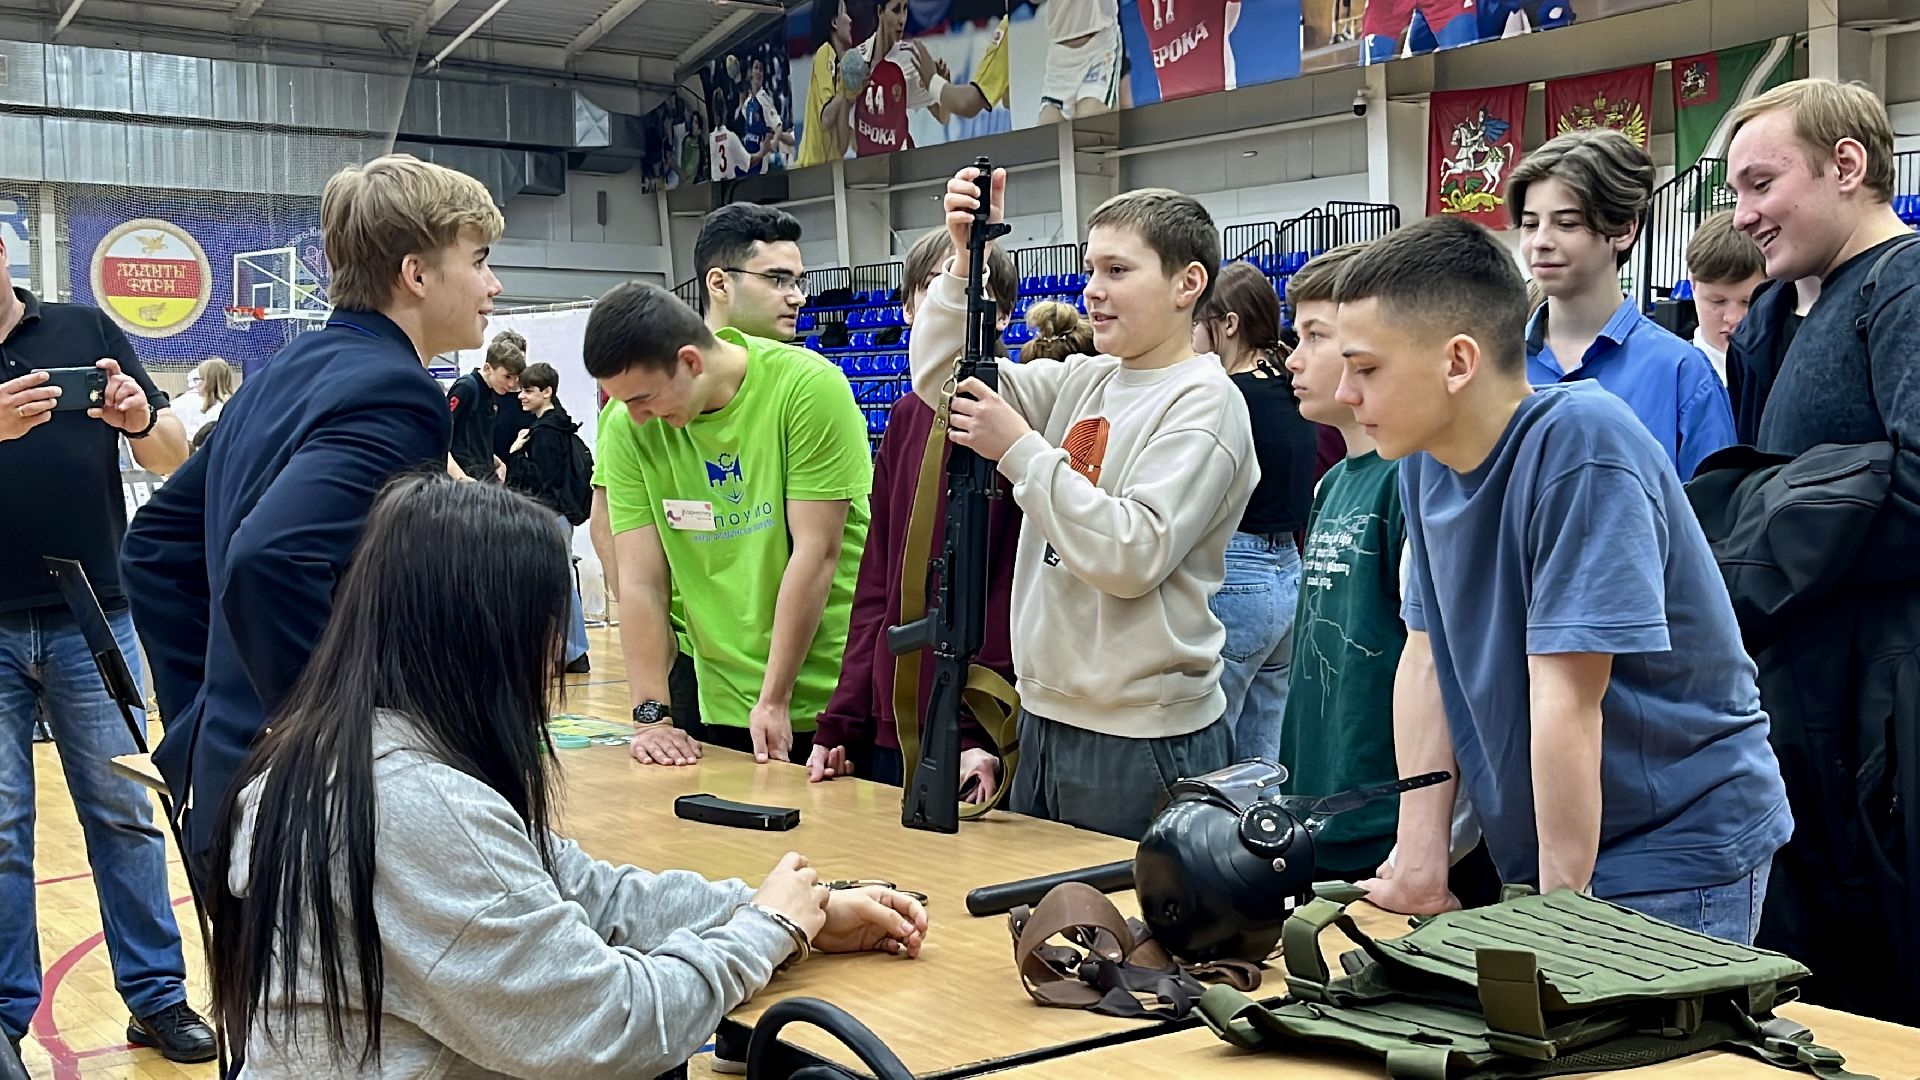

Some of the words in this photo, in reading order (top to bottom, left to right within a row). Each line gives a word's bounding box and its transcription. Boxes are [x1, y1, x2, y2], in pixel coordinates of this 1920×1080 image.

[1152, 21, 1209, 69] EPOKA
[865, 85, 885, 116] 44
[858, 119, 897, 146] EPOKA
[718, 144, 728, 173] 3
